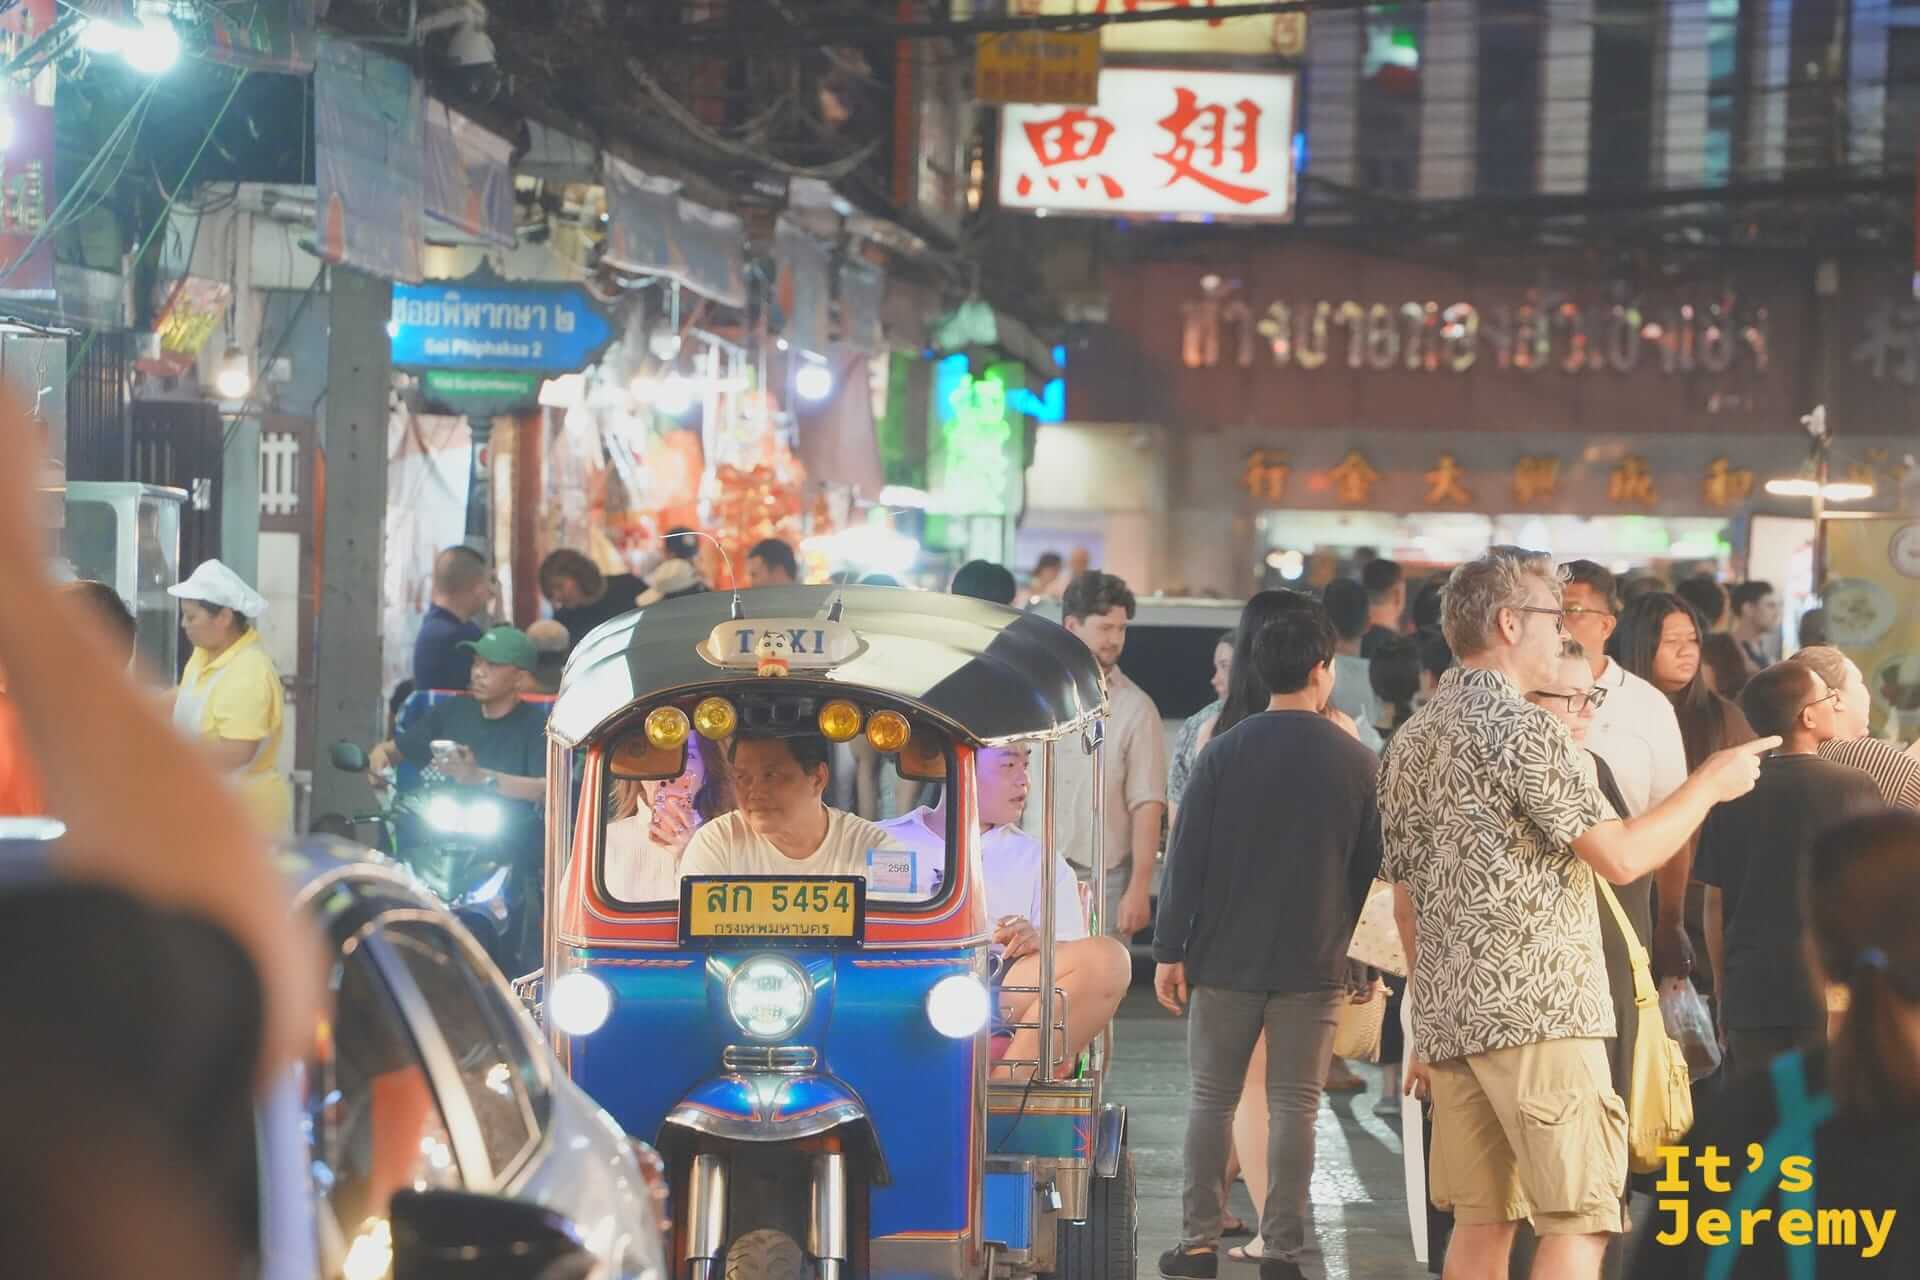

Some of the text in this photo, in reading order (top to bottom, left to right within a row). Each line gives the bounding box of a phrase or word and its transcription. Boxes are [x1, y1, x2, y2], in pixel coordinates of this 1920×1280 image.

[1016, 86, 1271, 205] 魚翅
[555, 304, 576, 333] ๒
[531, 341, 543, 358] 2
[736, 629, 824, 653] TXI
[706, 884, 850, 913] สก 5454
[713, 922, 830, 936] กรงเทพมหานคร
